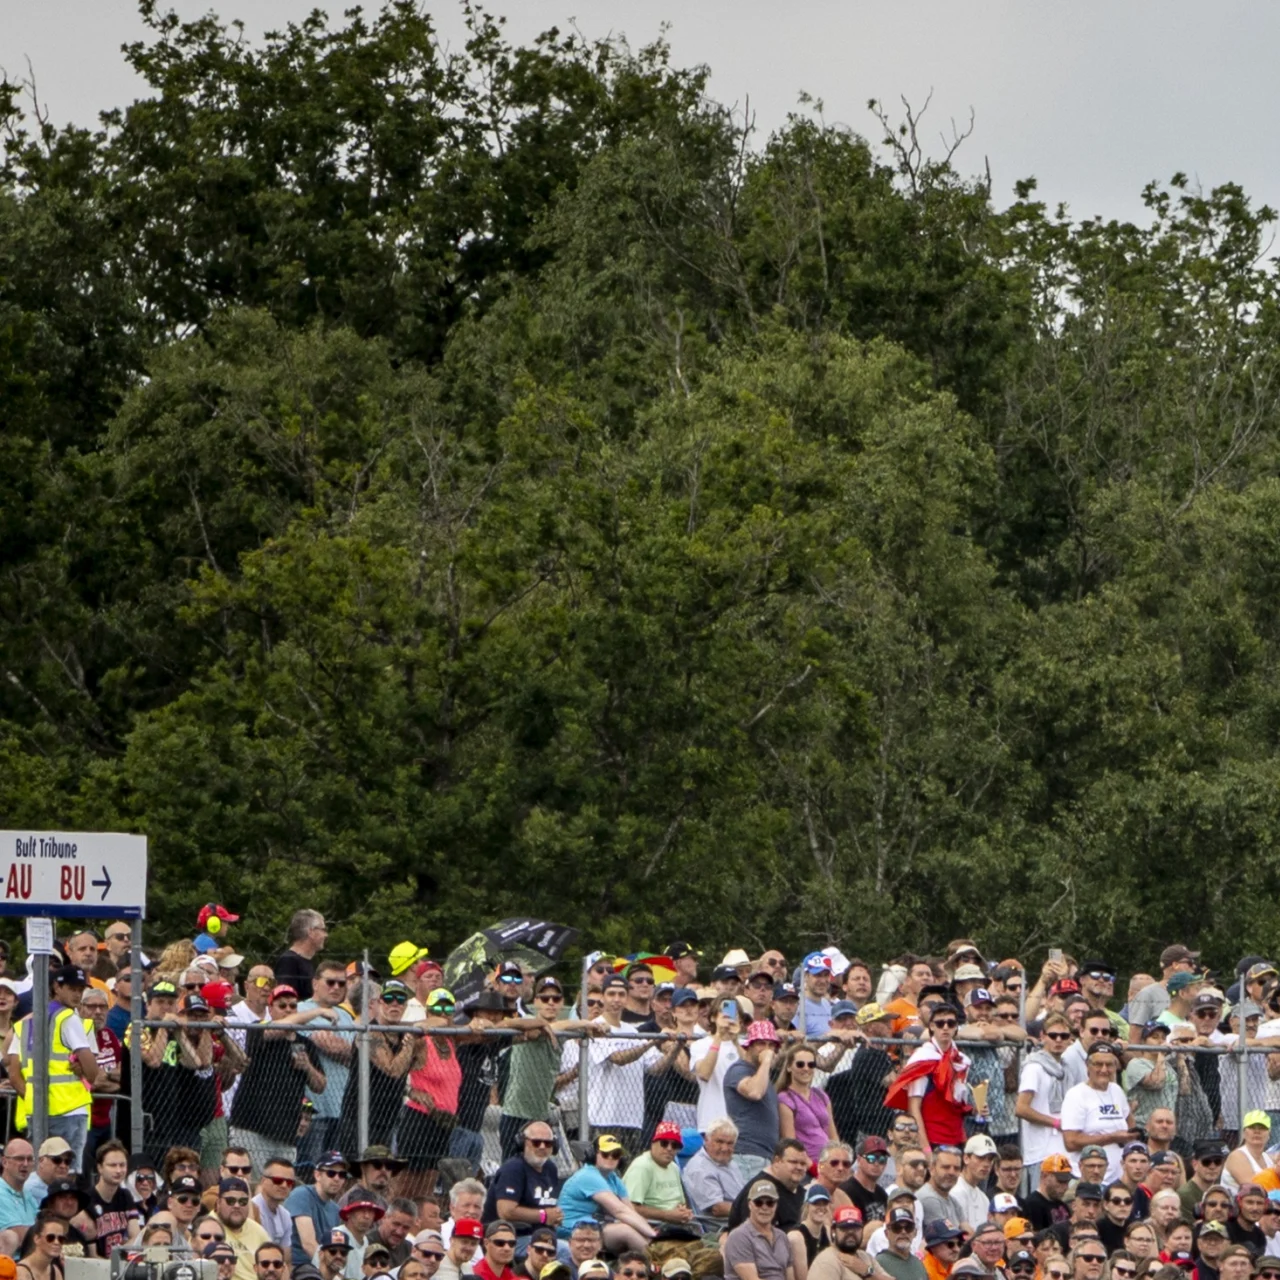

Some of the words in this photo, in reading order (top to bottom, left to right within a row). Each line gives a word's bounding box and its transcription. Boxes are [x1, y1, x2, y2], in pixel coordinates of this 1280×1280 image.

[16, 836, 36, 858] Bult
[40, 836, 77, 859] Tribune
[6, 863, 32, 899] AU
[60, 865, 85, 901] BU
